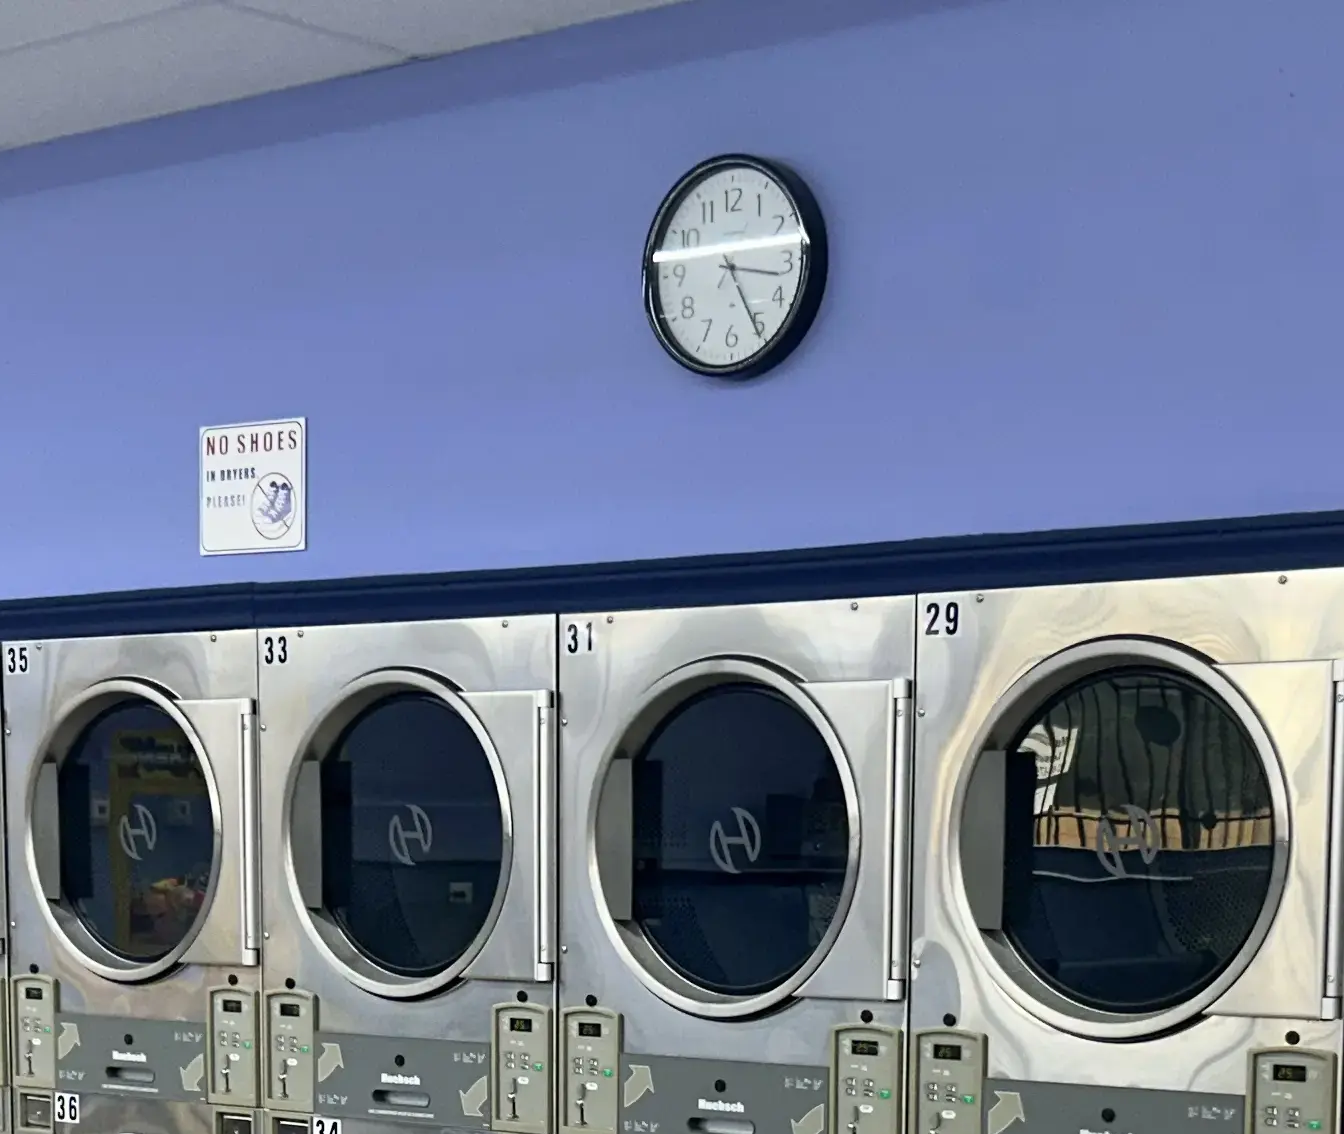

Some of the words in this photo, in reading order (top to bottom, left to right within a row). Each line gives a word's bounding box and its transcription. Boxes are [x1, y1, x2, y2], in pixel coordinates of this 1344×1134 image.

[701, 200, 714, 224] 11
[724, 188, 743, 212] 12
[681, 228, 700, 248] 10
[779, 250, 793, 275] 3
[673, 264, 686, 287] 9
[681, 296, 694, 319] 8
[772, 285, 785, 308] 4
[701, 318, 712, 343] 7
[752, 312, 765, 336] 5
[725, 325, 739, 348] 6
[206, 435, 229, 456] NO
[237, 430, 297, 454] SHOES
[206, 470, 216, 483] IN
[220, 467, 256, 482] DRYERS
[206, 494, 246, 509] PLEASE!
[925, 602, 959, 636] 29
[264, 635, 288, 665] 33
[567, 622, 594, 654] 31
[7, 647, 29, 673] 35
[57, 1095, 78, 1122] 36
